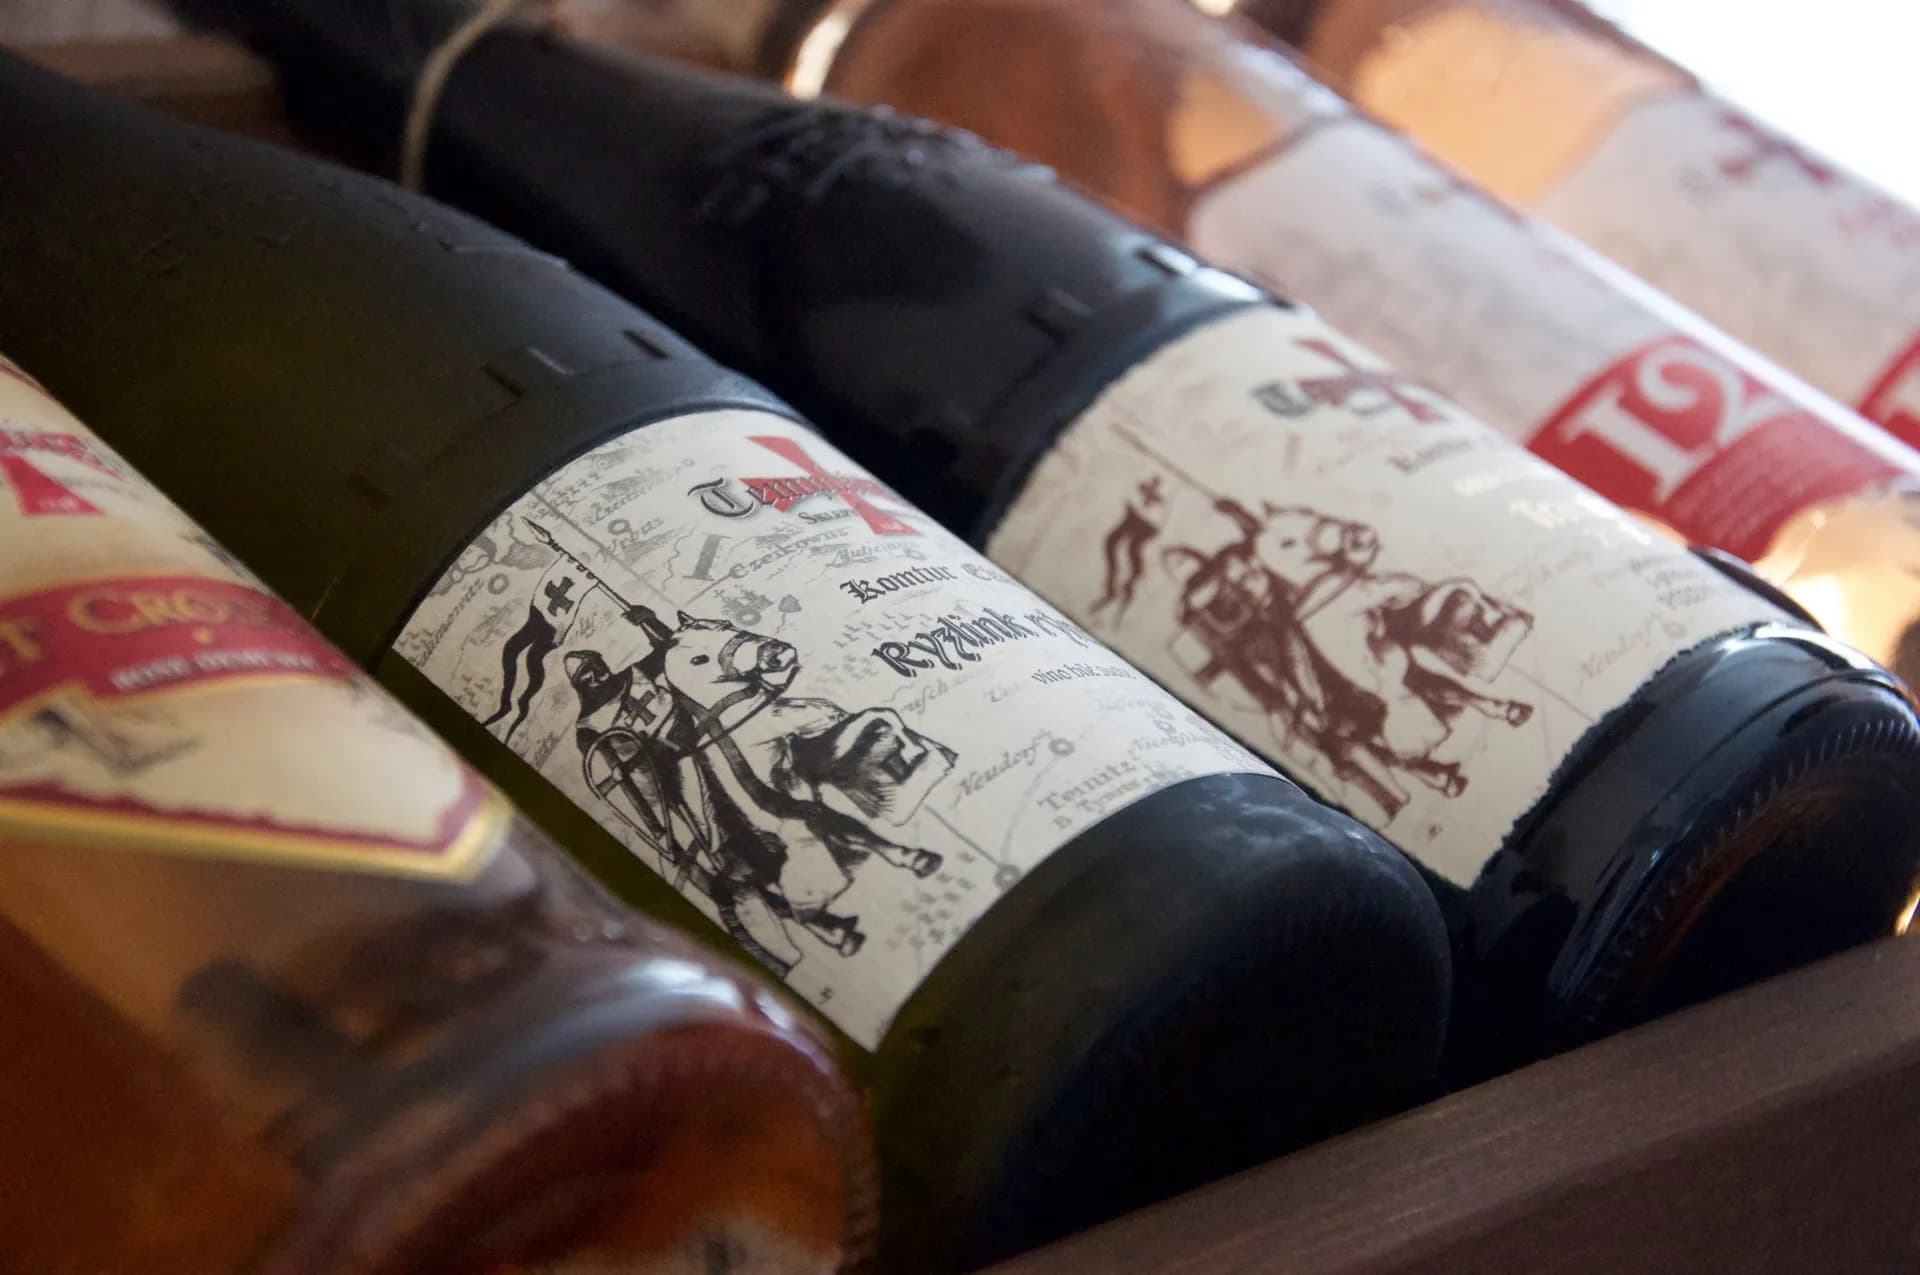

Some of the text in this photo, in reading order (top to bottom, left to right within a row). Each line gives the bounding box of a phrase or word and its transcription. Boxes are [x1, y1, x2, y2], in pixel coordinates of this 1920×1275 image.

[1556, 342, 1798, 506] 12
[839, 565, 957, 604] Komtur
[870, 607, 1039, 677] Ryzlink
